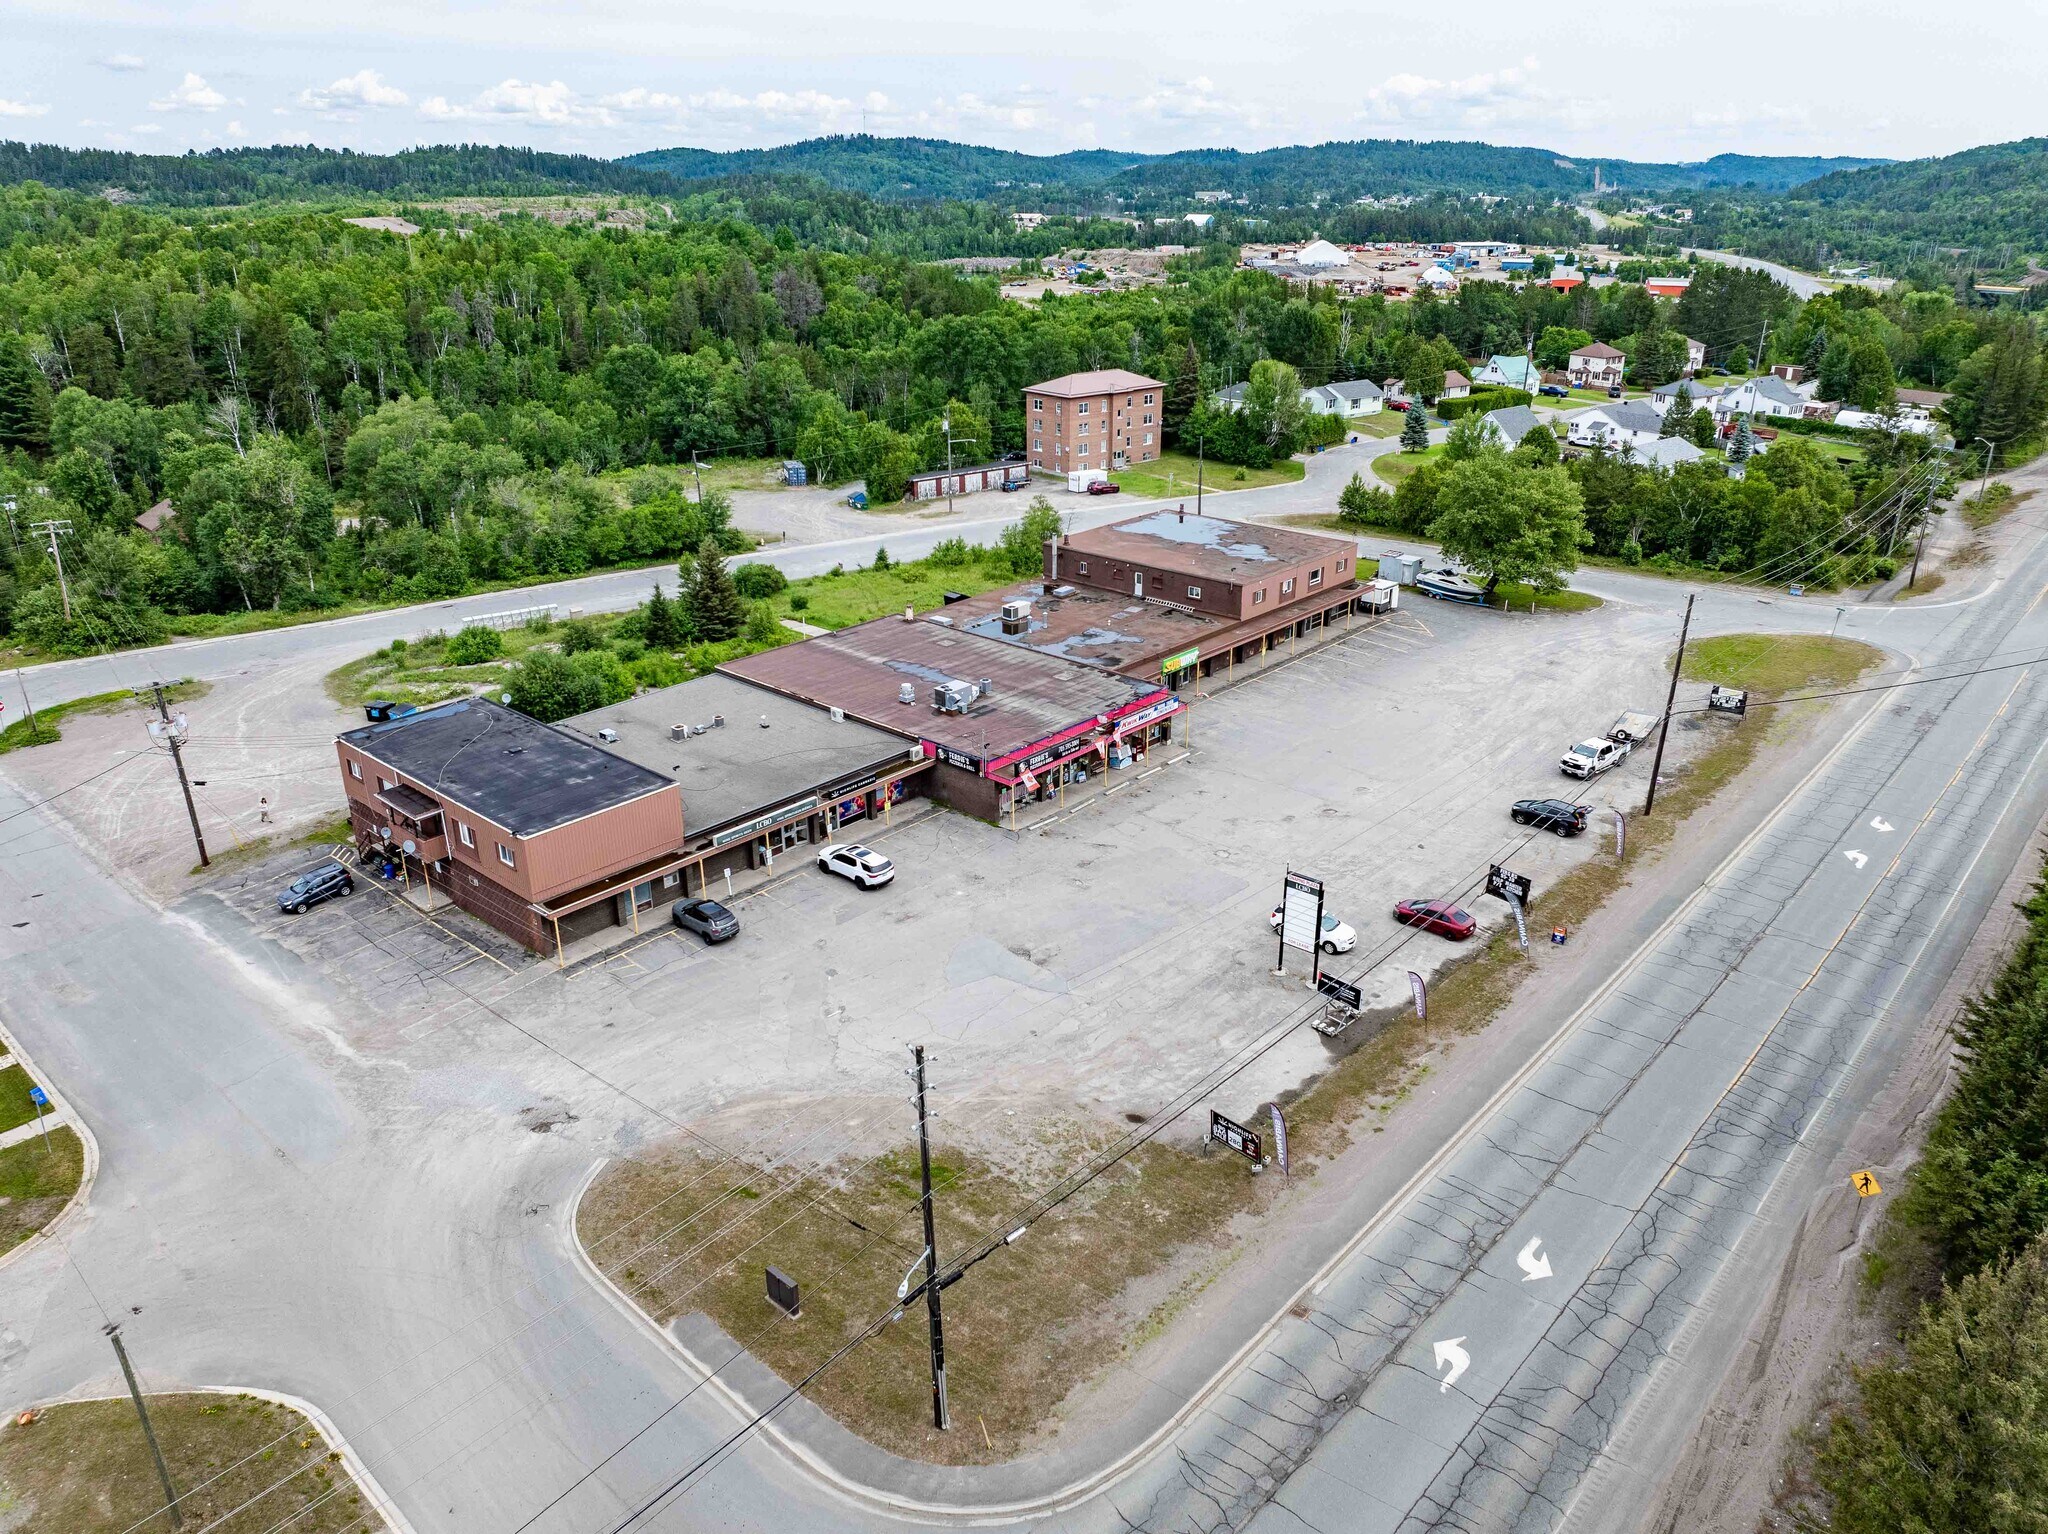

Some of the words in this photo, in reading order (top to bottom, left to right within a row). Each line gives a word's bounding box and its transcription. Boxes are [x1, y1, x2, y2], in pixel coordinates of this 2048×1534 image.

[1164, 651, 1200, 671] SUBWAY
[756, 818, 772, 830] LCBO
[1295, 883, 1310, 892] LCBO
